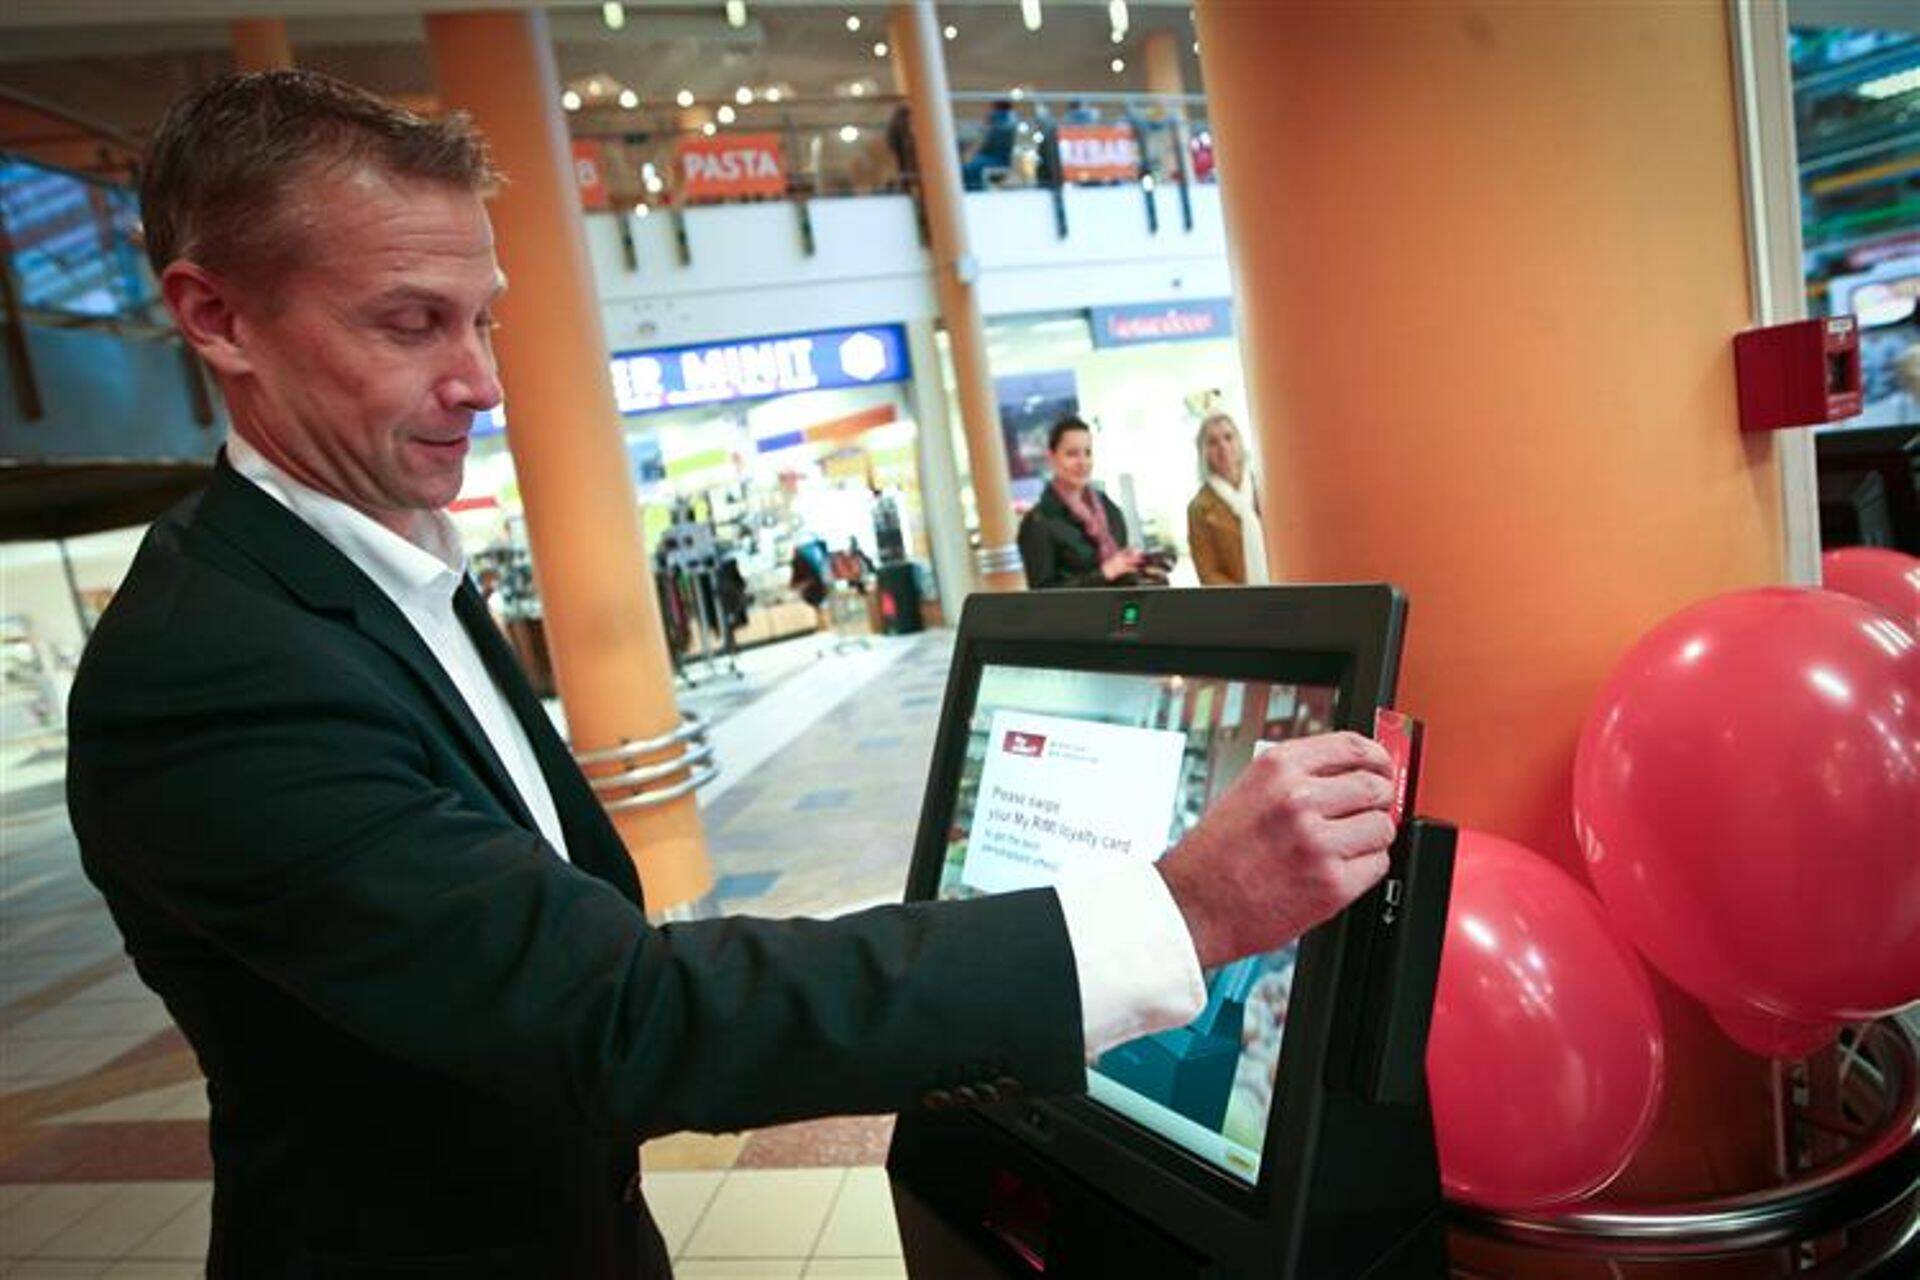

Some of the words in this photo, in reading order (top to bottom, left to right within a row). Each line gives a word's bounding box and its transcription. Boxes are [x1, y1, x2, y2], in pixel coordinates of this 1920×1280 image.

[683, 149, 779, 182] PASTA
[680, 338, 819, 393] MINIT
[993, 786, 1026, 805] Please
[987, 808, 1012, 823] your
[1014, 811, 1029, 830] My
[1059, 823, 1098, 849] loyalty
[1101, 836, 1132, 854] card
